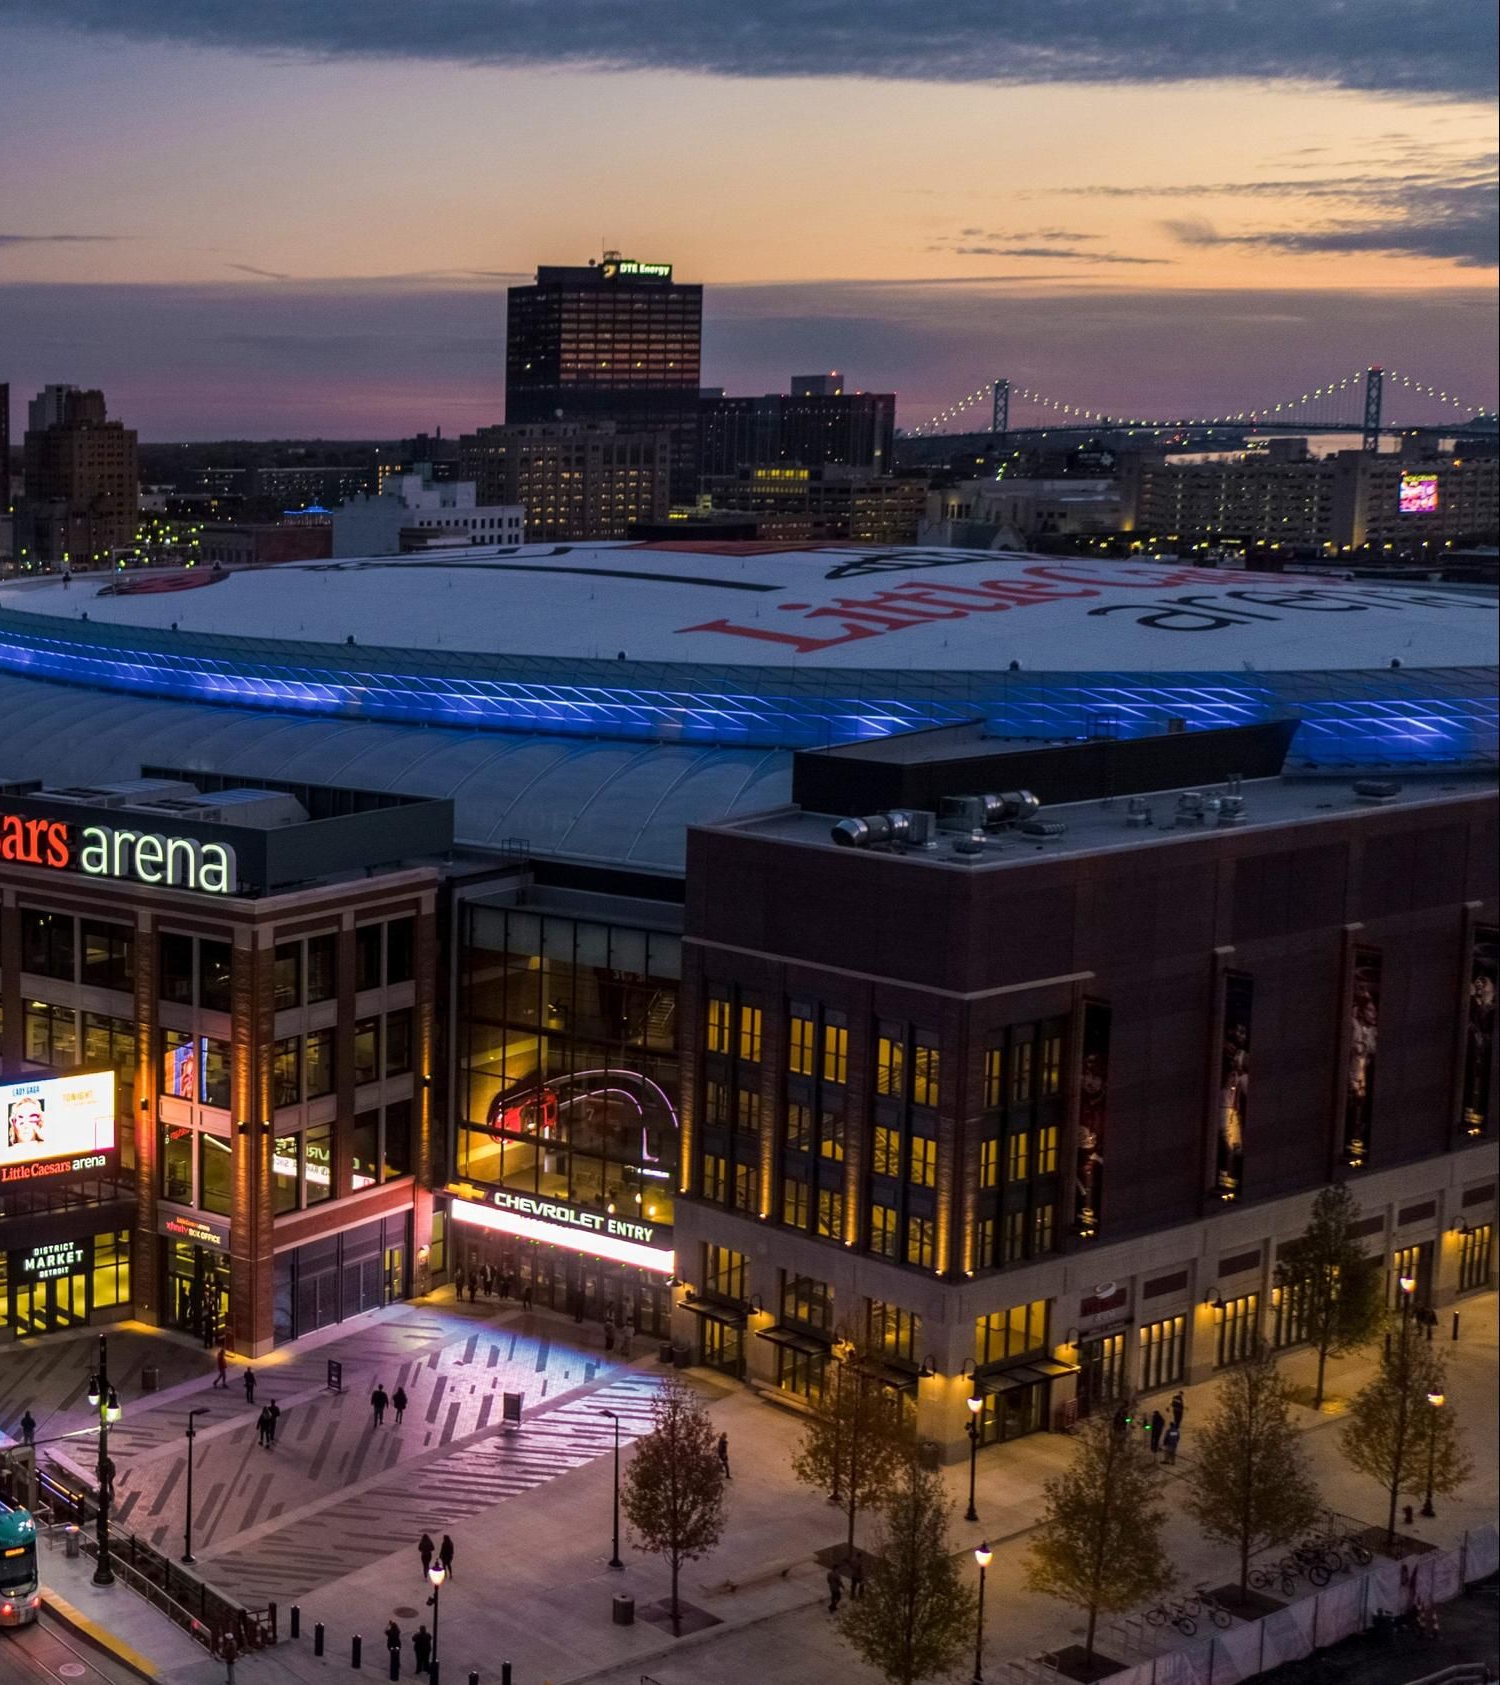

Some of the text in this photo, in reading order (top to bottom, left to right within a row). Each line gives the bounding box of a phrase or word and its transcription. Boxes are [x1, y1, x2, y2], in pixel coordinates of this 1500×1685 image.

[620, 263, 670, 276] DTE Energy
[674, 579, 1101, 653] Little
[81, 826, 231, 893] arena
[1, 1155, 106, 1181] Little Caesars arena
[494, 1192, 653, 1242] CHEVROLET ENTRY
[24, 1250, 84, 1271] MARKET
[33, 1242, 74, 1257] DISTRICT
[39, 1266, 69, 1278] DETROIT
